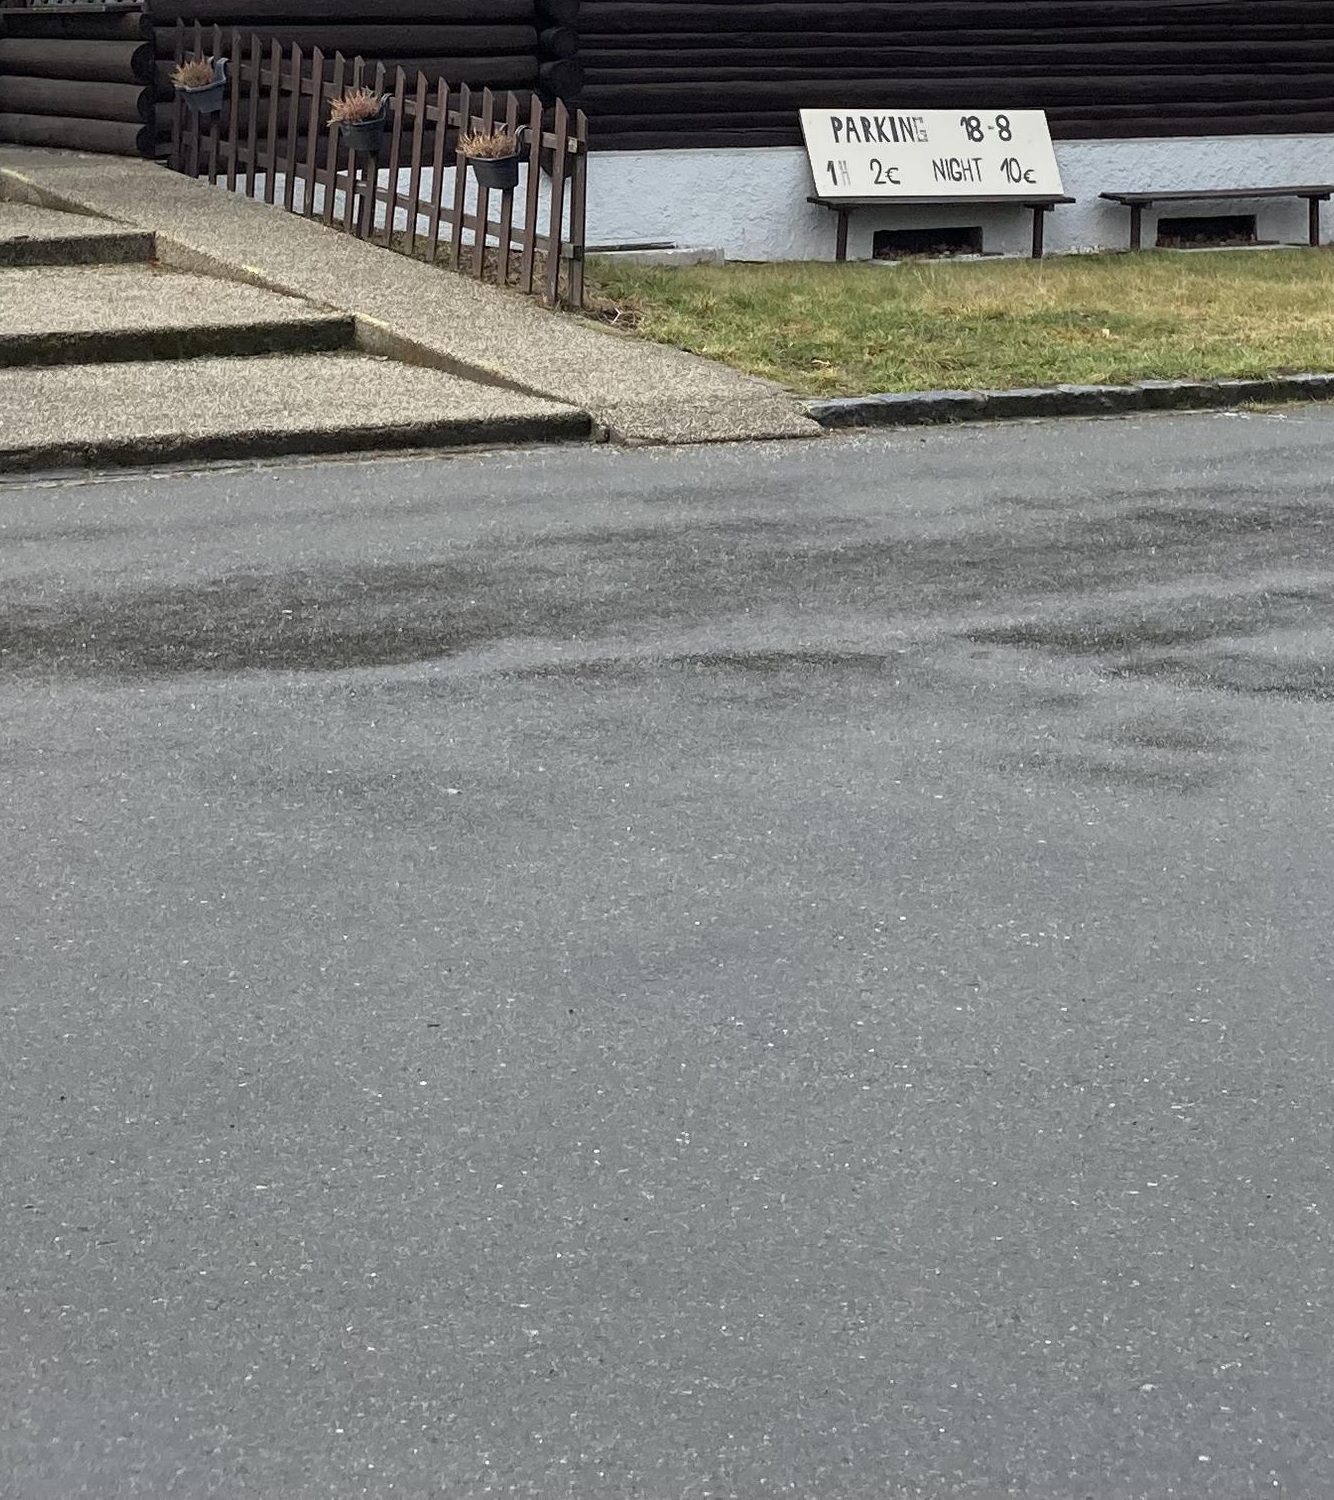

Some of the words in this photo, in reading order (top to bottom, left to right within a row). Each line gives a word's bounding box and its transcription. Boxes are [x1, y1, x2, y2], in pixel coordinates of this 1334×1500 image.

[830, 116, 929, 143] PARKING
[870, 158, 901, 185] 2€
[932, 157, 983, 182] NIGHT
[1000, 157, 1037, 184] 10€
